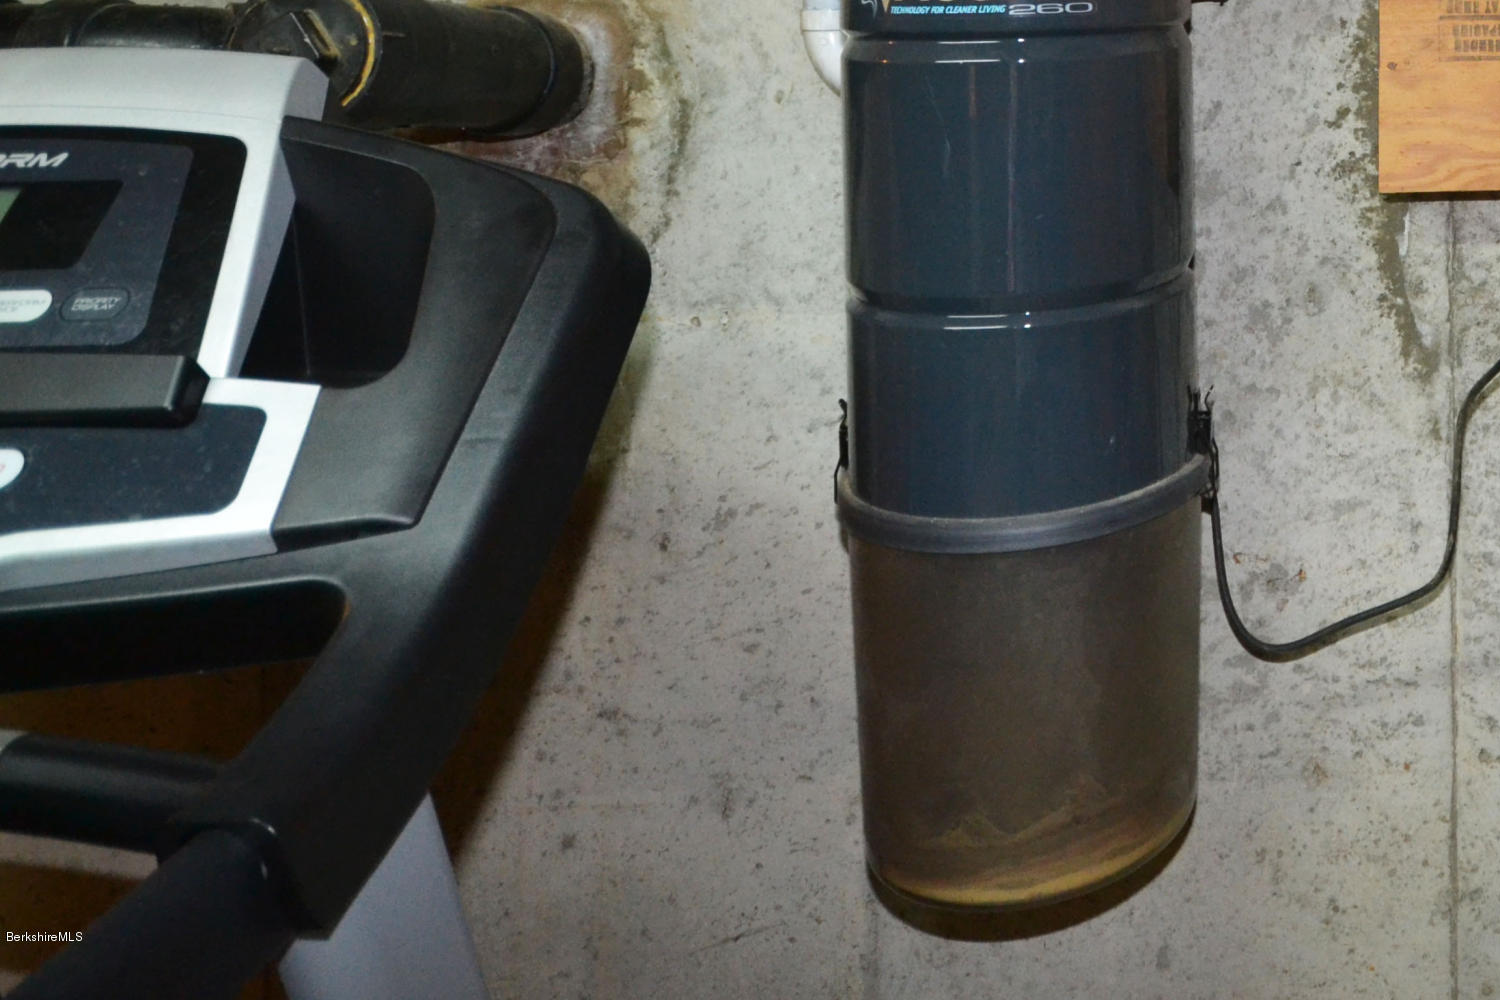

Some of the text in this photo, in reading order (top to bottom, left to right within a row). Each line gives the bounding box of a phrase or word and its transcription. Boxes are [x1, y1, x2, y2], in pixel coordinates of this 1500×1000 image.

[890, 4, 1006, 14] TECHNOLOGY FOR CLEANER LIVING
[1008, 2, 1094, 16] 260
[0, 152, 69, 168] RM
